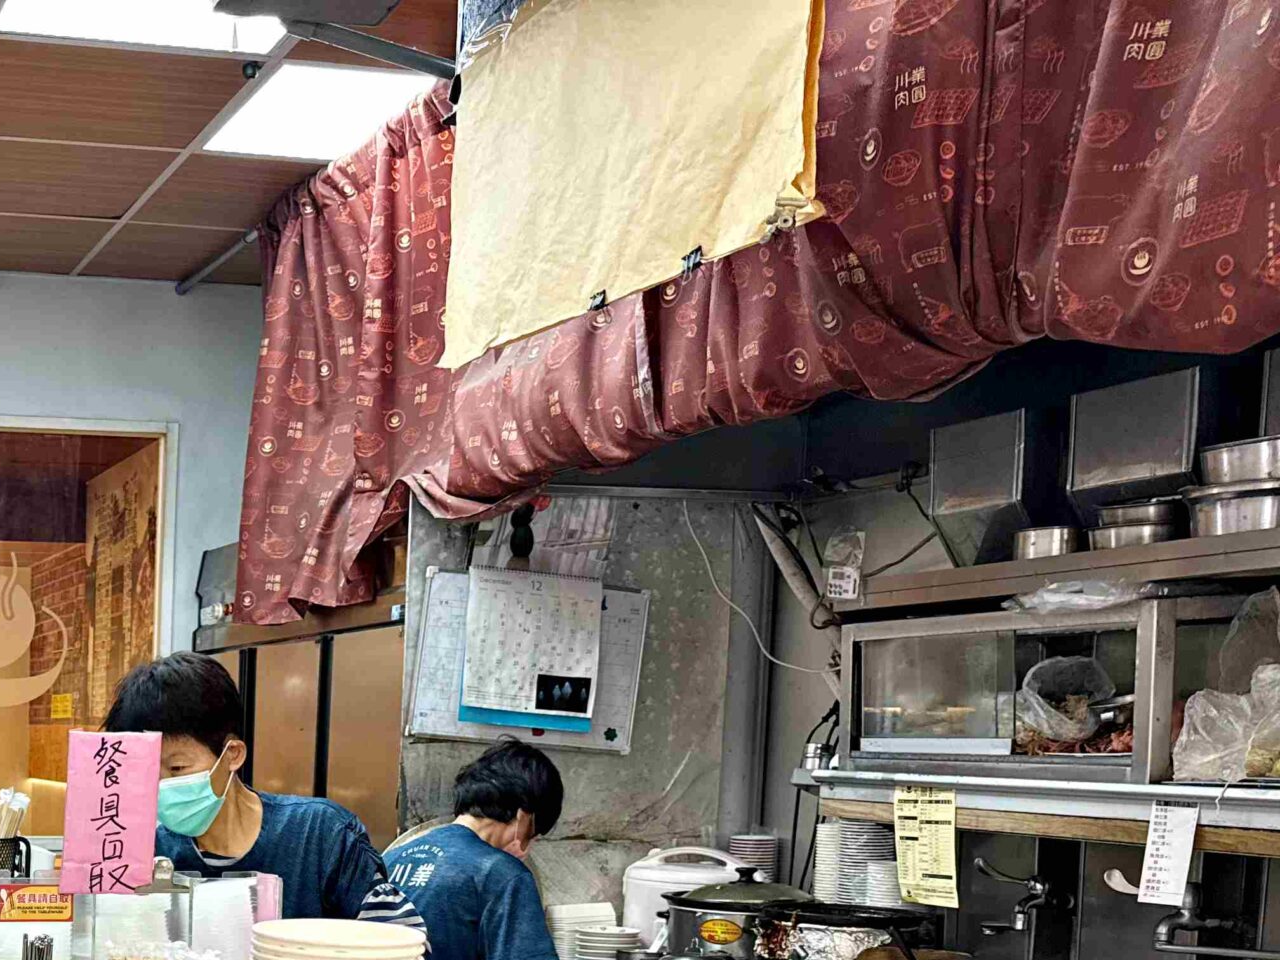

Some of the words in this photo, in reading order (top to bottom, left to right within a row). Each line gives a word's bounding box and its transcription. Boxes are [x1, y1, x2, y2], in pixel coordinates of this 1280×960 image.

[1129, 19, 1172, 40] 川業
[1123, 41, 1166, 61] 肉圓
[895, 66, 926, 91] 川業
[895, 85, 926, 110] 肉圓
[480, 576, 513, 587] December
[530, 580, 544, 592] 12
[89, 737, 136, 893] 餐具自取
[388, 863, 436, 887] 川業
[17, 893, 69, 904] 餐具請自取
